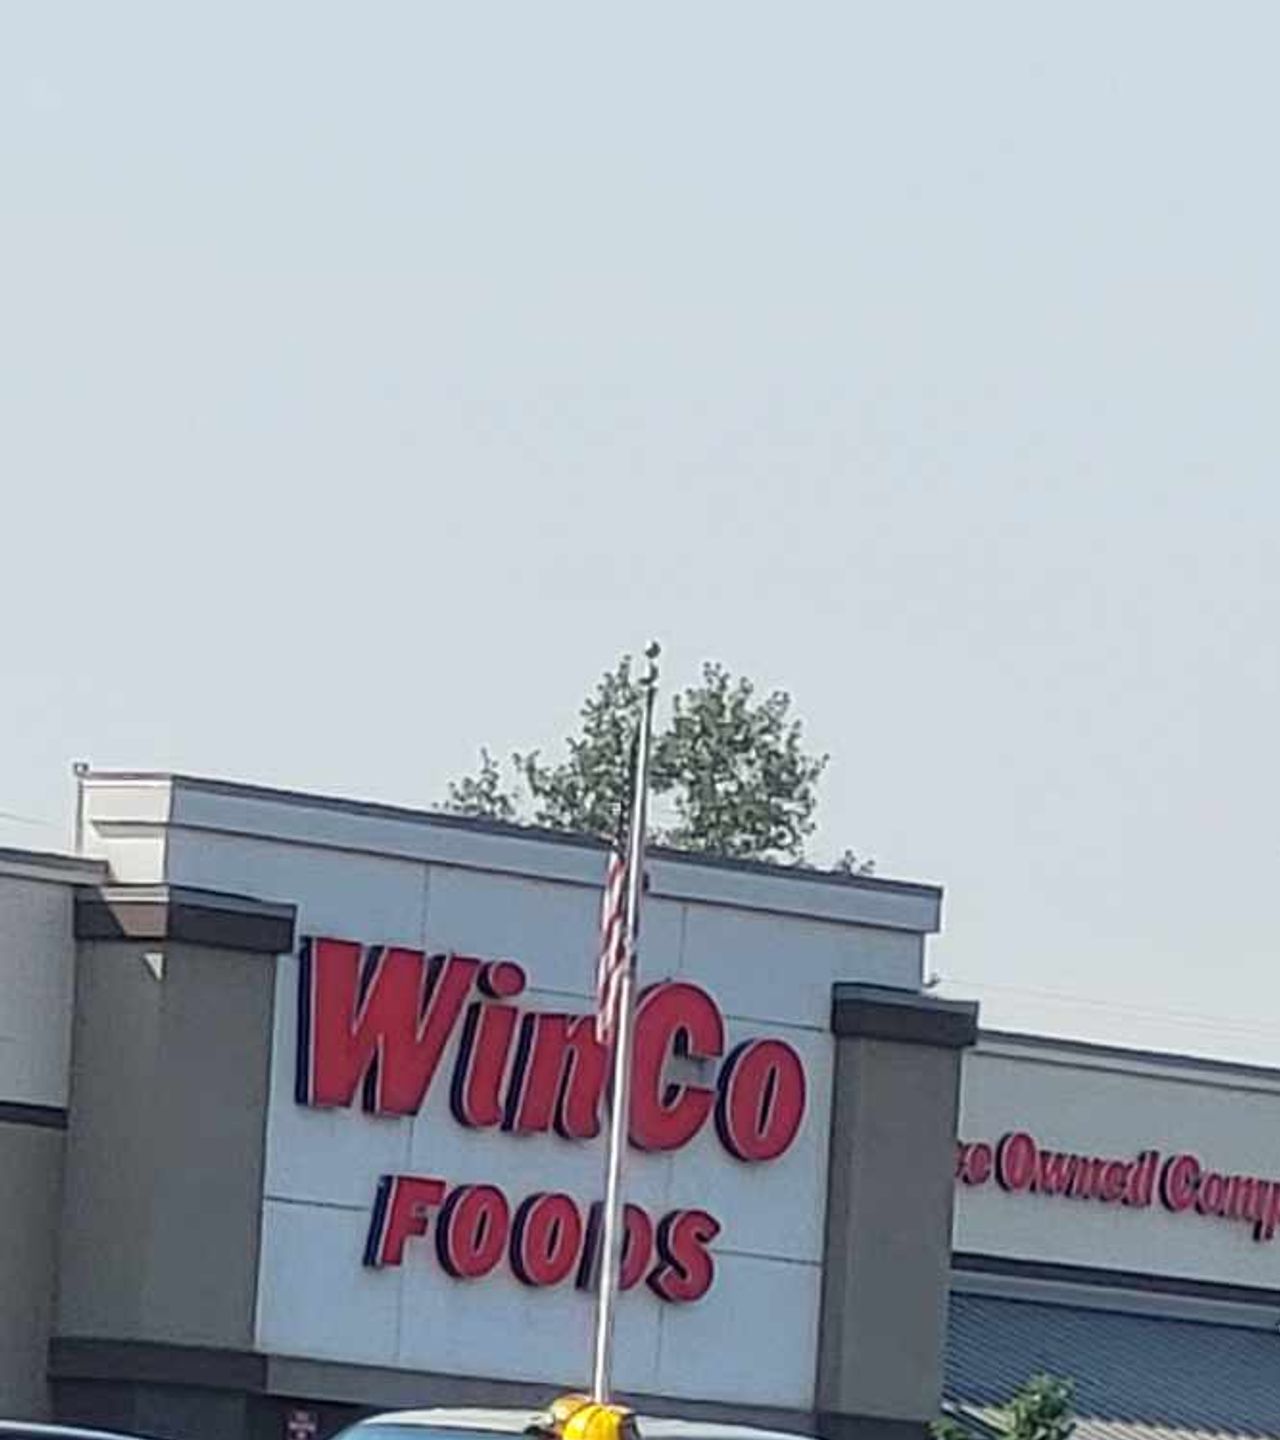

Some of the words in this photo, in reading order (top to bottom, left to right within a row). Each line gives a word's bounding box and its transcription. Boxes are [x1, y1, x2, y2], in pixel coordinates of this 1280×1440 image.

[295, 935, 807, 1163] WinCo
[996, 1132, 1162, 1208] Owned
[362, 1174, 722, 1303] FOODS
